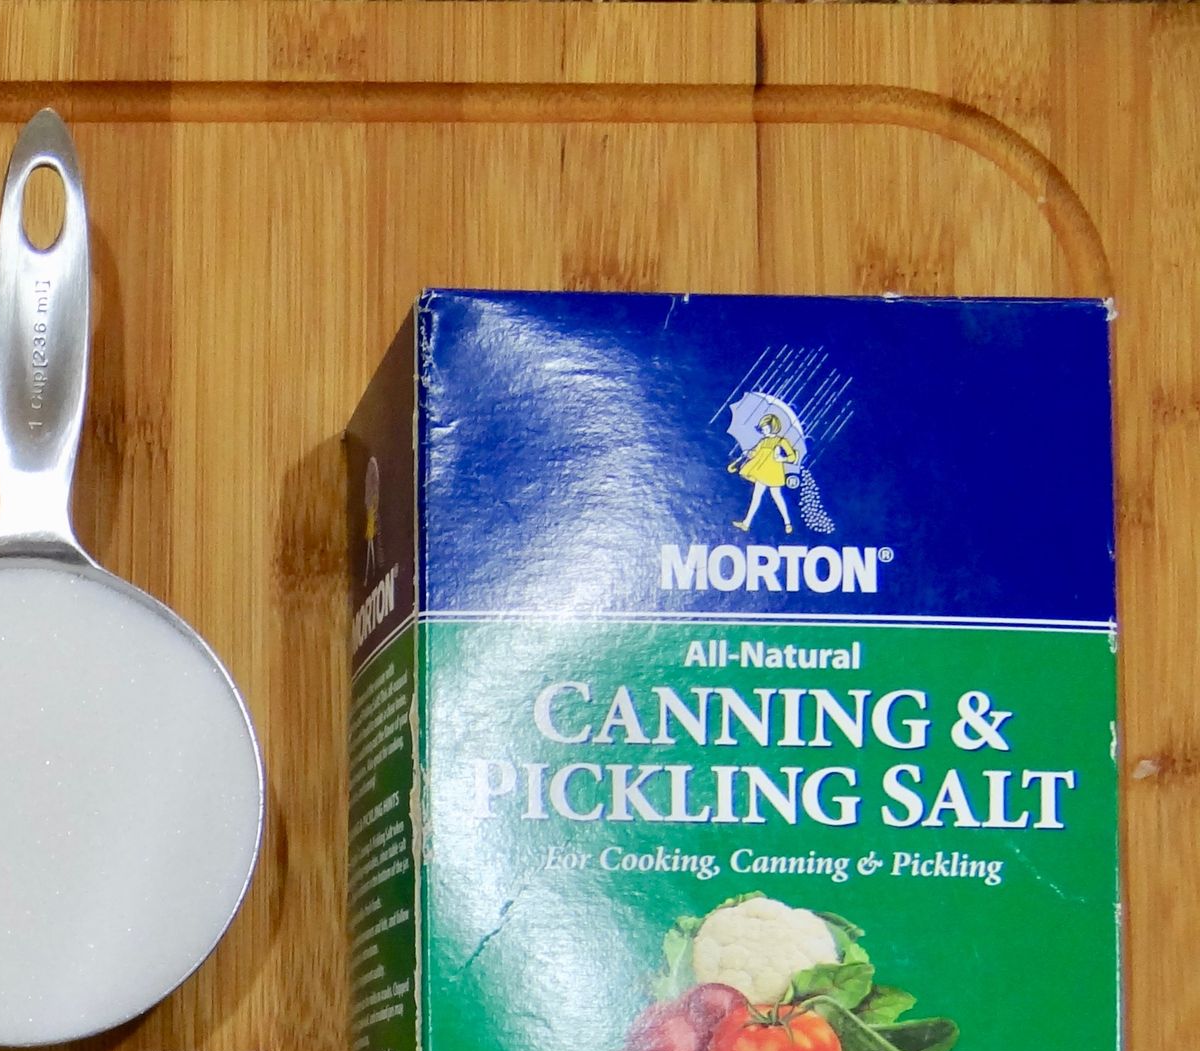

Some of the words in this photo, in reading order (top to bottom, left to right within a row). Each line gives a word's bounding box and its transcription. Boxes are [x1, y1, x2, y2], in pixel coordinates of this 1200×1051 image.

[684, 639, 862, 671] All-Natural
[533, 681, 931, 752] CANNING
[950, 690, 1013, 752] &
[471, 757, 863, 828] PICKLING
[880, 763, 1076, 830] SALT
[544, 846, 592, 871] For
[599, 846, 721, 881] Cooking,
[730, 848, 850, 883] Canning
[856, 851, 883, 876] &
[890, 851, 1004, 886] Pickling
